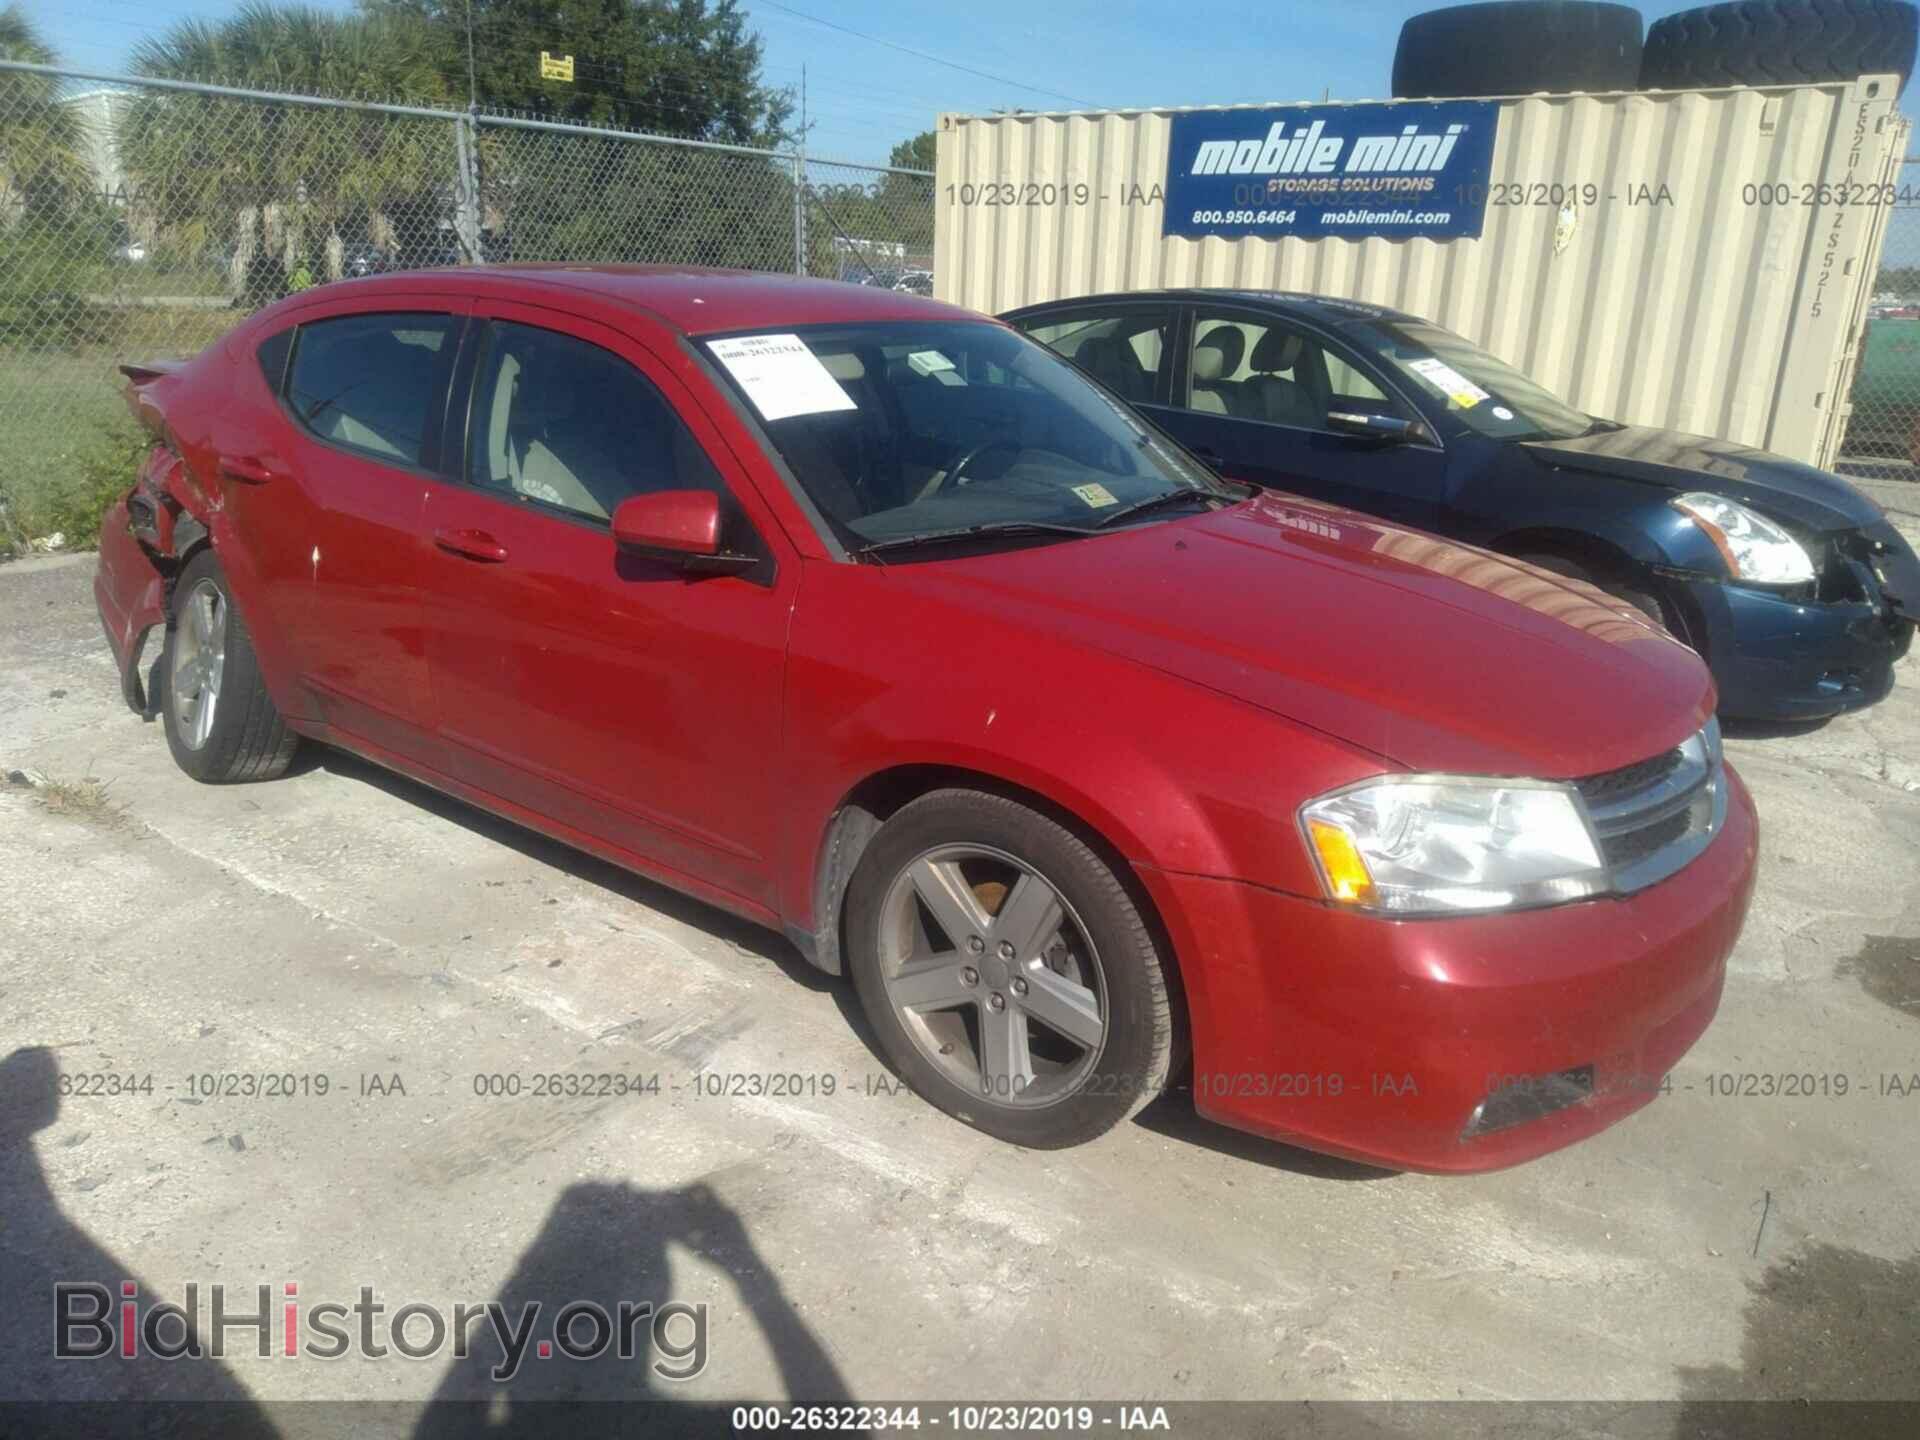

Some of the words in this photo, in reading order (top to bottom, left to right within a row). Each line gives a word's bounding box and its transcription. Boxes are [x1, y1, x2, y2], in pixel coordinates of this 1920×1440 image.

[1191, 120, 1344, 175] mobile
[1345, 124, 1464, 172] mini
[1267, 178, 1339, 193] STORAGE
[1342, 177, 1435, 192] SOLUTIONS
[1192, 210, 1296, 225] 800.950.6464
[1321, 209, 1451, 225] mobilemini.com
